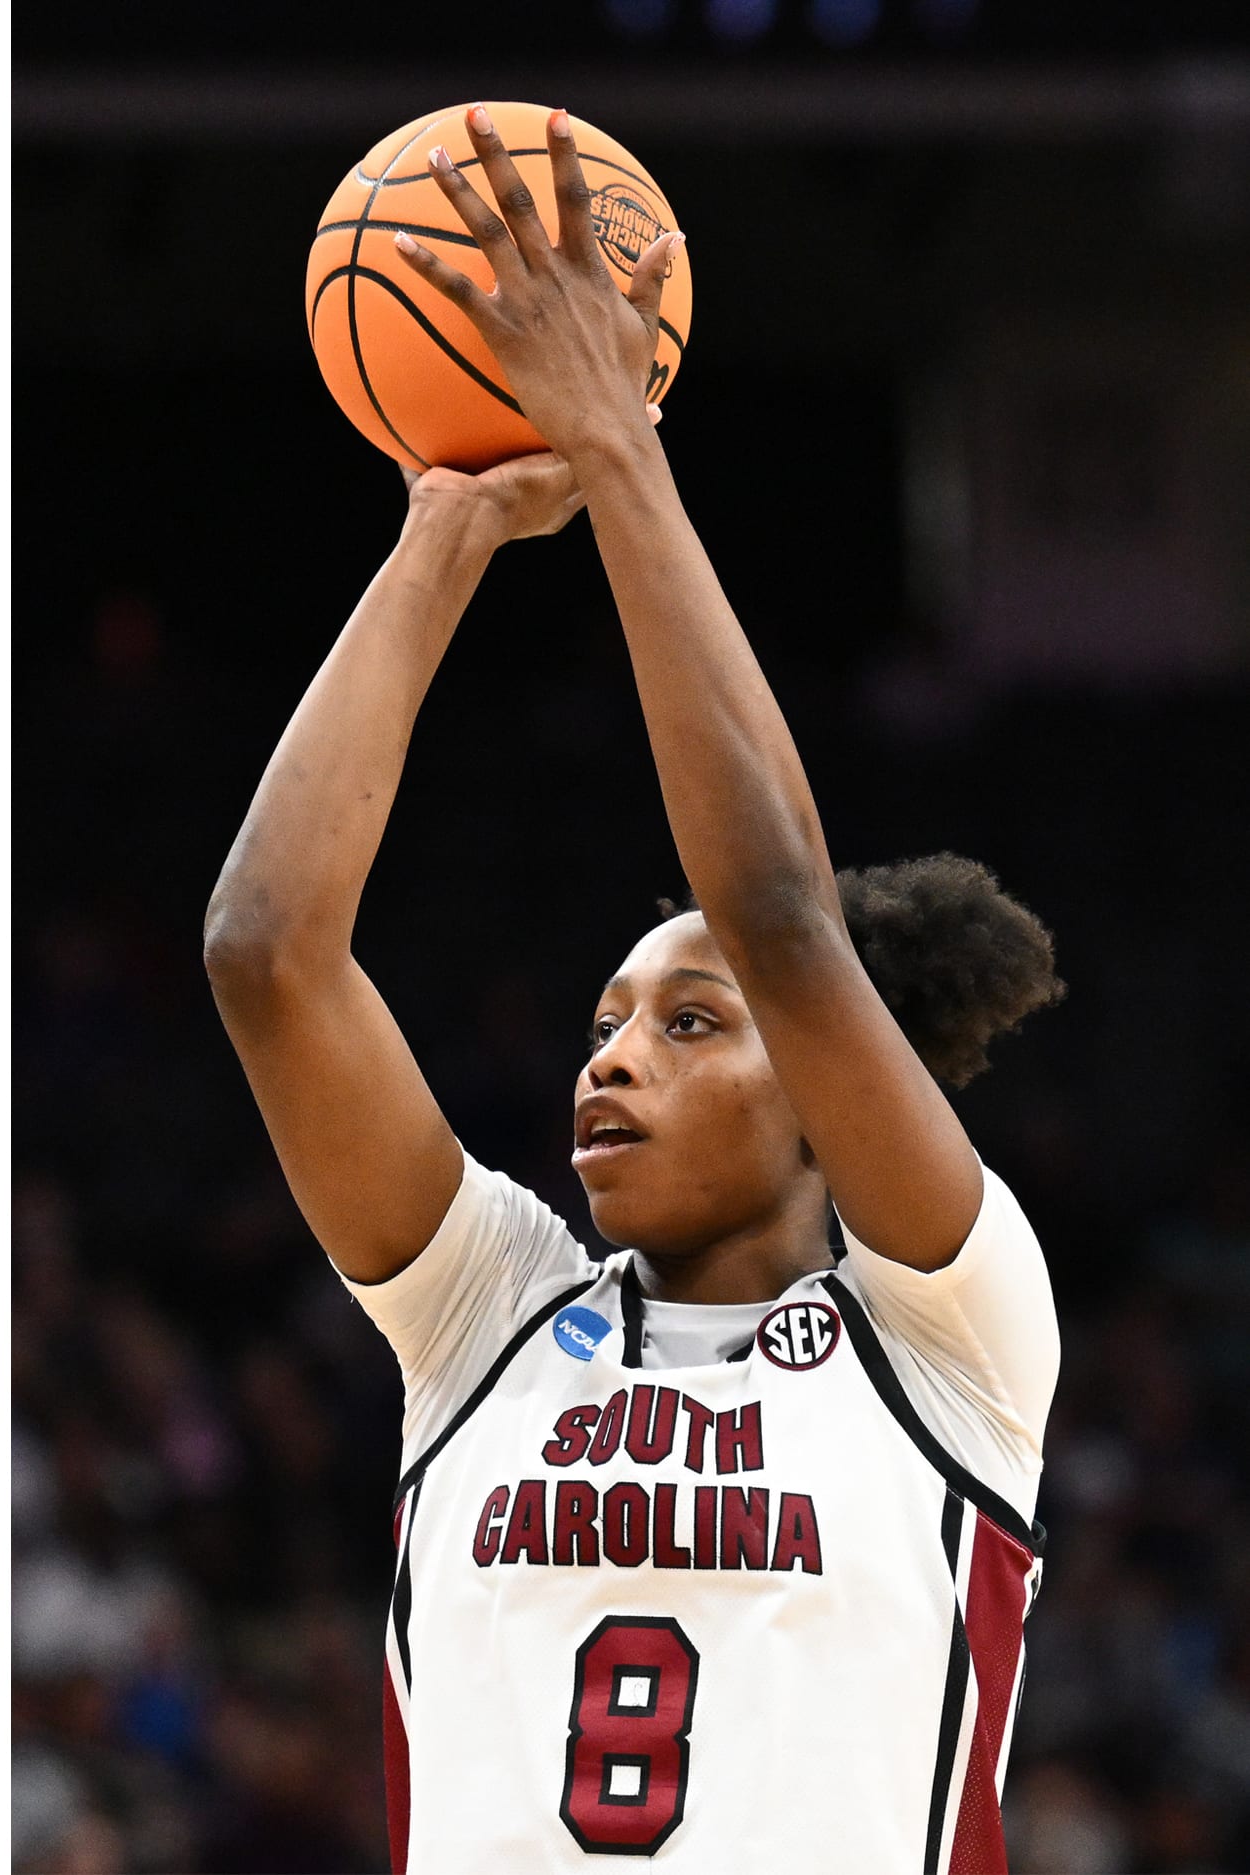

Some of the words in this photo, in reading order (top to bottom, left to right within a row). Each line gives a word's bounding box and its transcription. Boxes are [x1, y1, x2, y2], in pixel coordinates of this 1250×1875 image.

[590, 194, 658, 243] MADNES
[607, 222, 650, 256] ARCH
[558, 1319, 597, 1351] NCA
[764, 1306, 833, 1364] SEC
[541, 1384, 764, 1474] SOUTH
[472, 1480, 823, 1576] CAROLINA
[559, 1615, 701, 1857] 8
